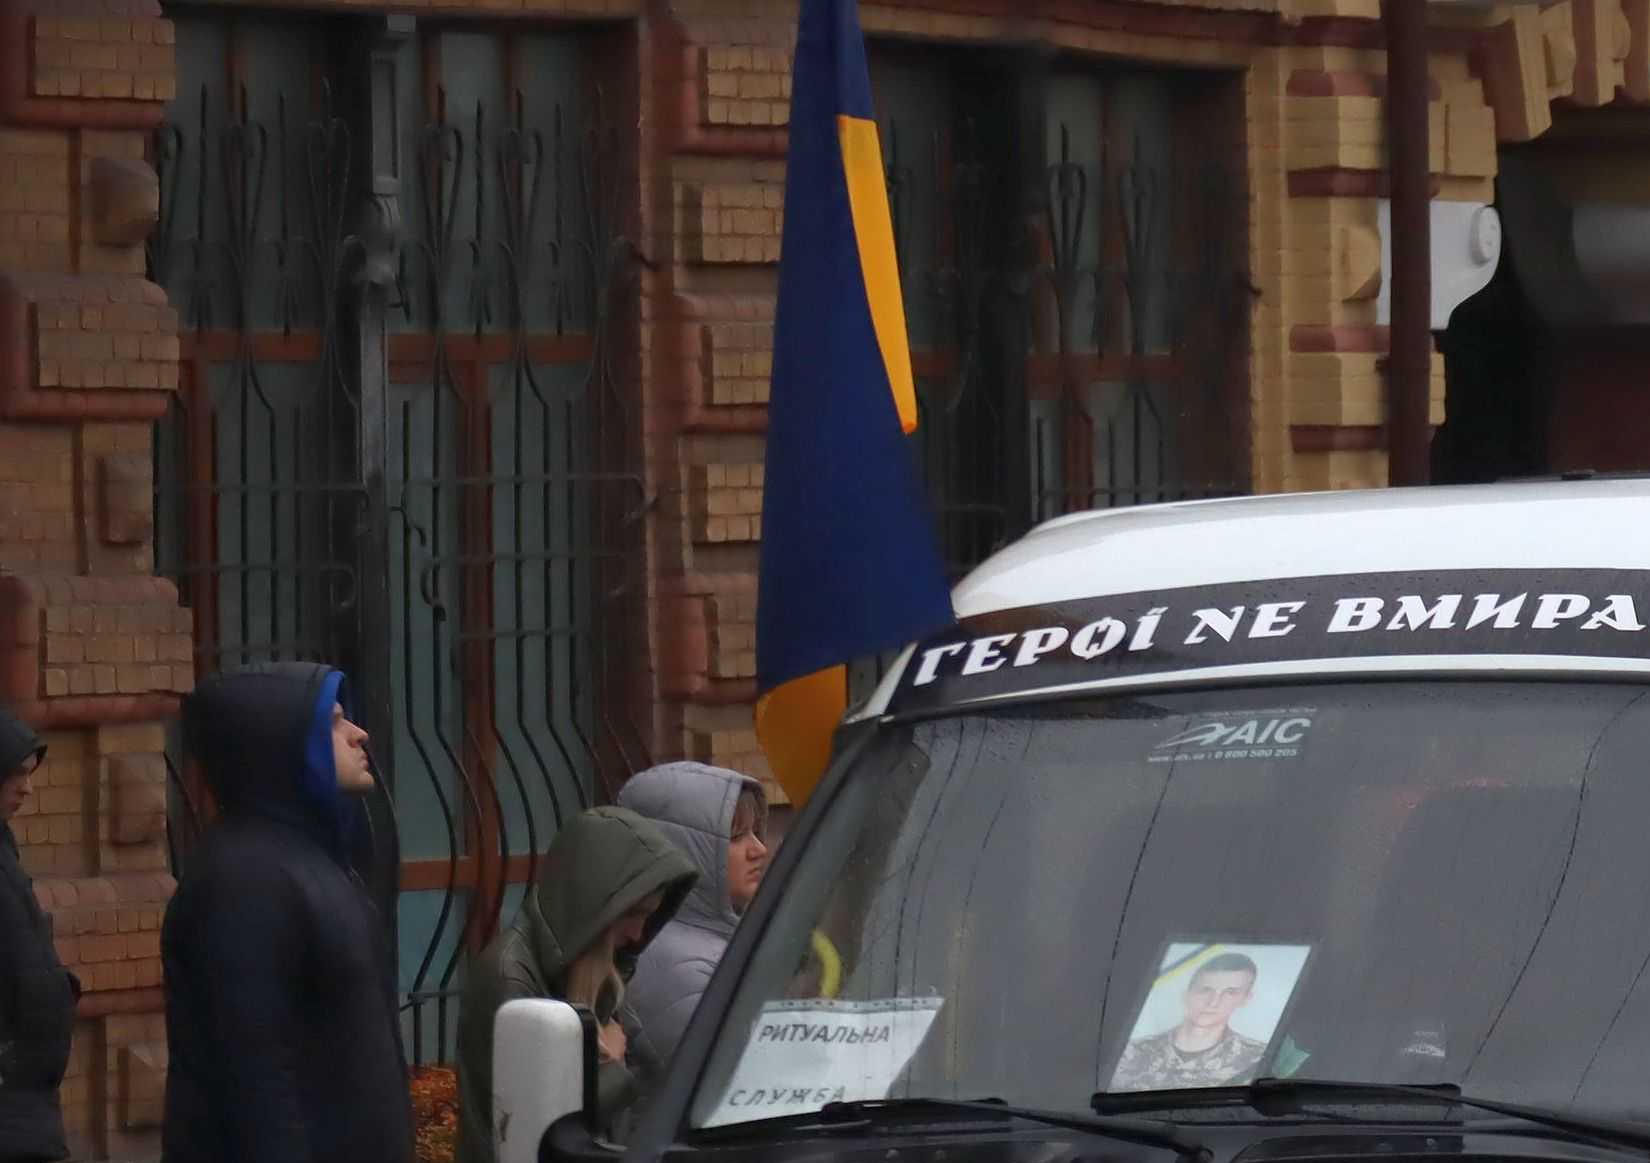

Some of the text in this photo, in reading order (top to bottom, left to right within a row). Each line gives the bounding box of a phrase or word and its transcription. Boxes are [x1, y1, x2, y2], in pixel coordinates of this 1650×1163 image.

[913, 606, 1169, 687] ГЕРОЇ
[757, 1023, 891, 1044] РИТУАЛЬНА
[729, 1085, 847, 1107] СЛУЖБА
